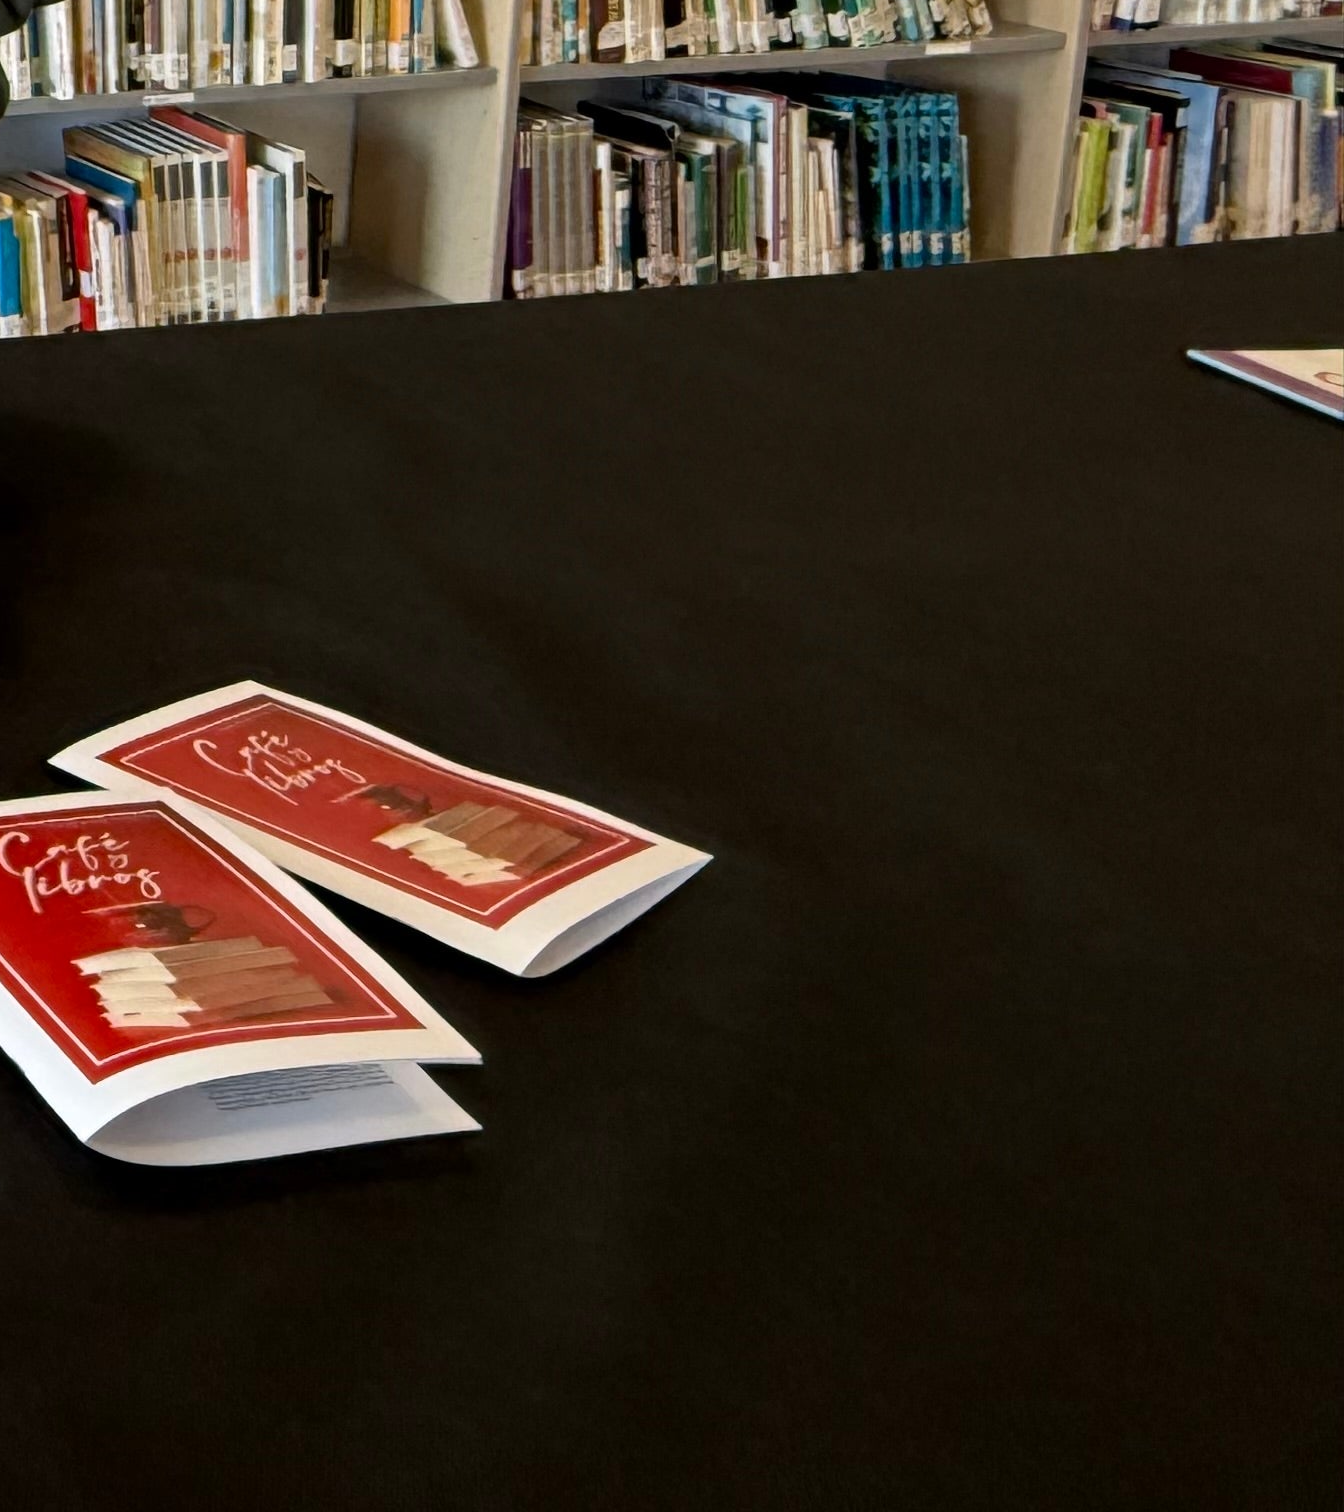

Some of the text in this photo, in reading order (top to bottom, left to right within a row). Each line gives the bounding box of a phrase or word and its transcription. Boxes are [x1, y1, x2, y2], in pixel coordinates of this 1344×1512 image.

[193, 730, 291, 778] Café
[242, 754, 367, 805] libros
[21, 848, 163, 915] libros
